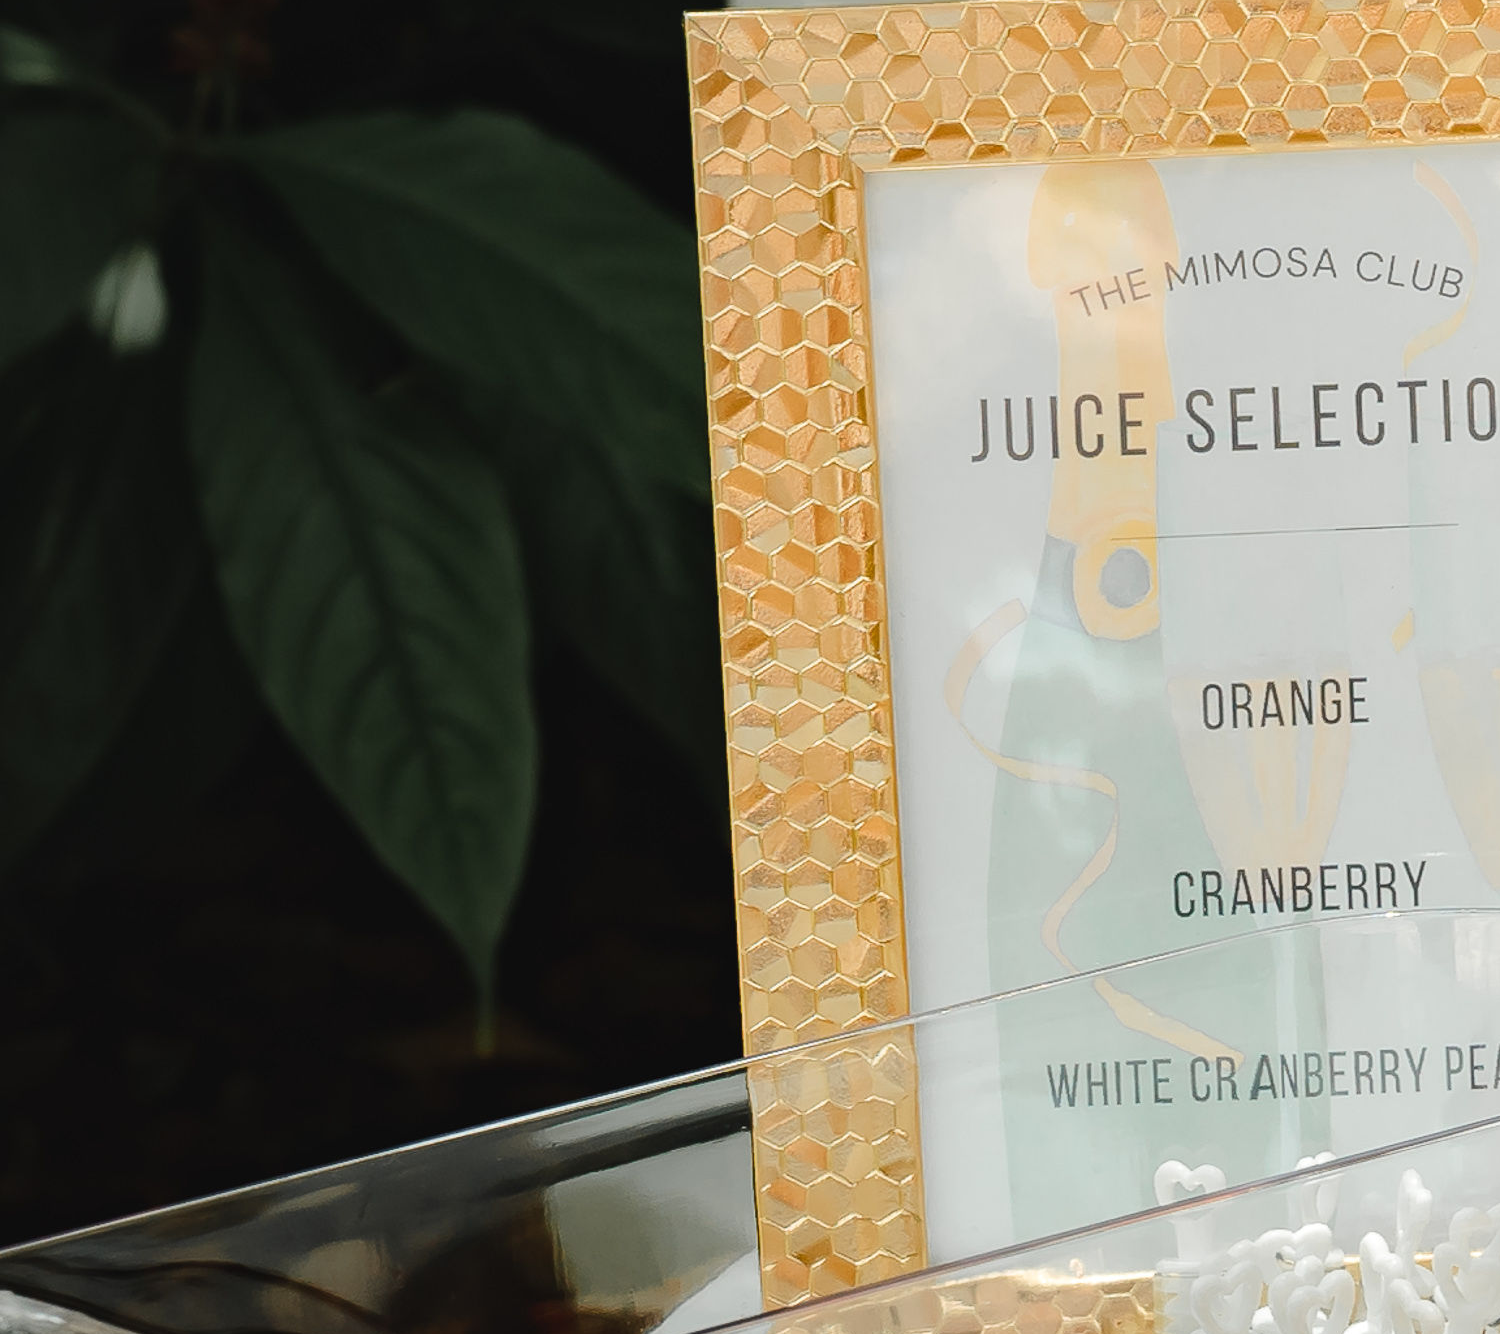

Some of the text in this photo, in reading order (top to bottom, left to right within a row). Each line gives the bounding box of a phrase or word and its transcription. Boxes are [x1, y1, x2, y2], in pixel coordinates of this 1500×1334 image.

[1069, 246, 1464, 317] THE MIMOSA CLUB
[971, 391, 1148, 463] JUICE
[1202, 677, 1370, 730] ORANGE
[1172, 860, 1427, 918] CRANBERRY
[1046, 1057, 1174, 1108] WHITE
[1189, 1046, 1428, 1103] CRANBERRY
